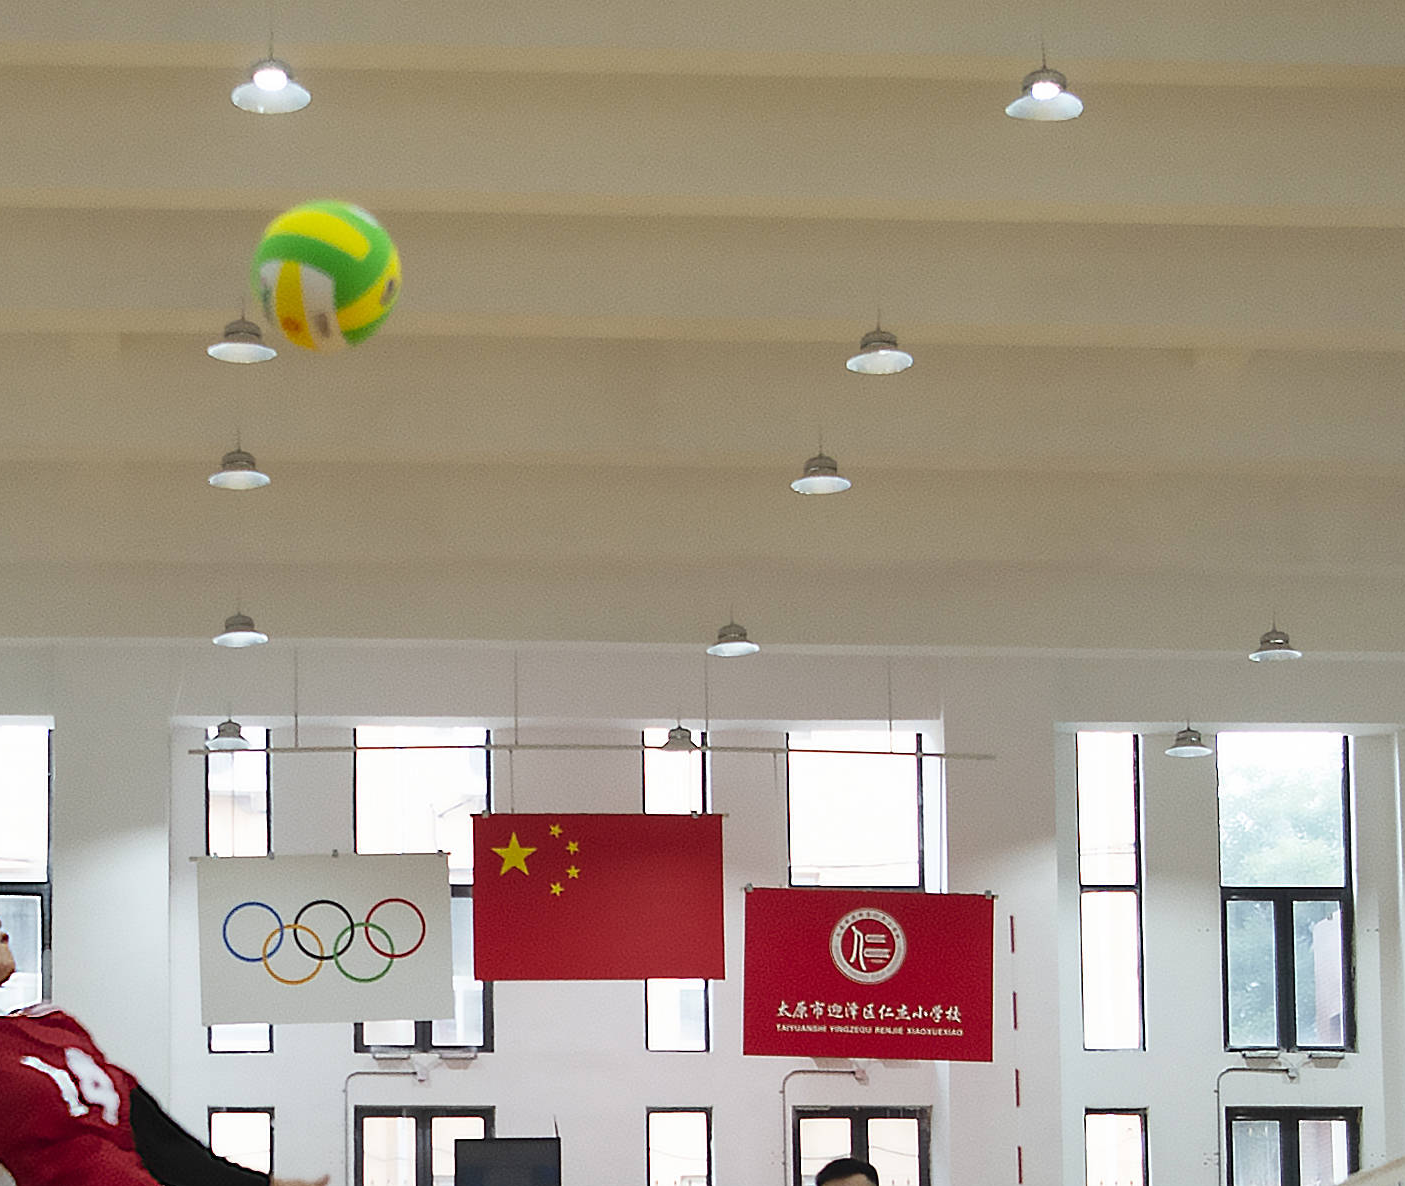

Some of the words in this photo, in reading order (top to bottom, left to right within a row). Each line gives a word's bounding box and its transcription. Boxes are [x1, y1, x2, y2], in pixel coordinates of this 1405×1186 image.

[777, 1000, 963, 1024] 太原市迎泽区仁杰小学校
[776, 1023, 827, 1033] TAIYUANSHI
[830, 1025, 873, 1034] YINGZEQU
[875, 1026, 904, 1036] RENJIE
[907, 1028, 964, 1037] XIAOXUEXIAO
[20, 1047, 121, 1127] 14
